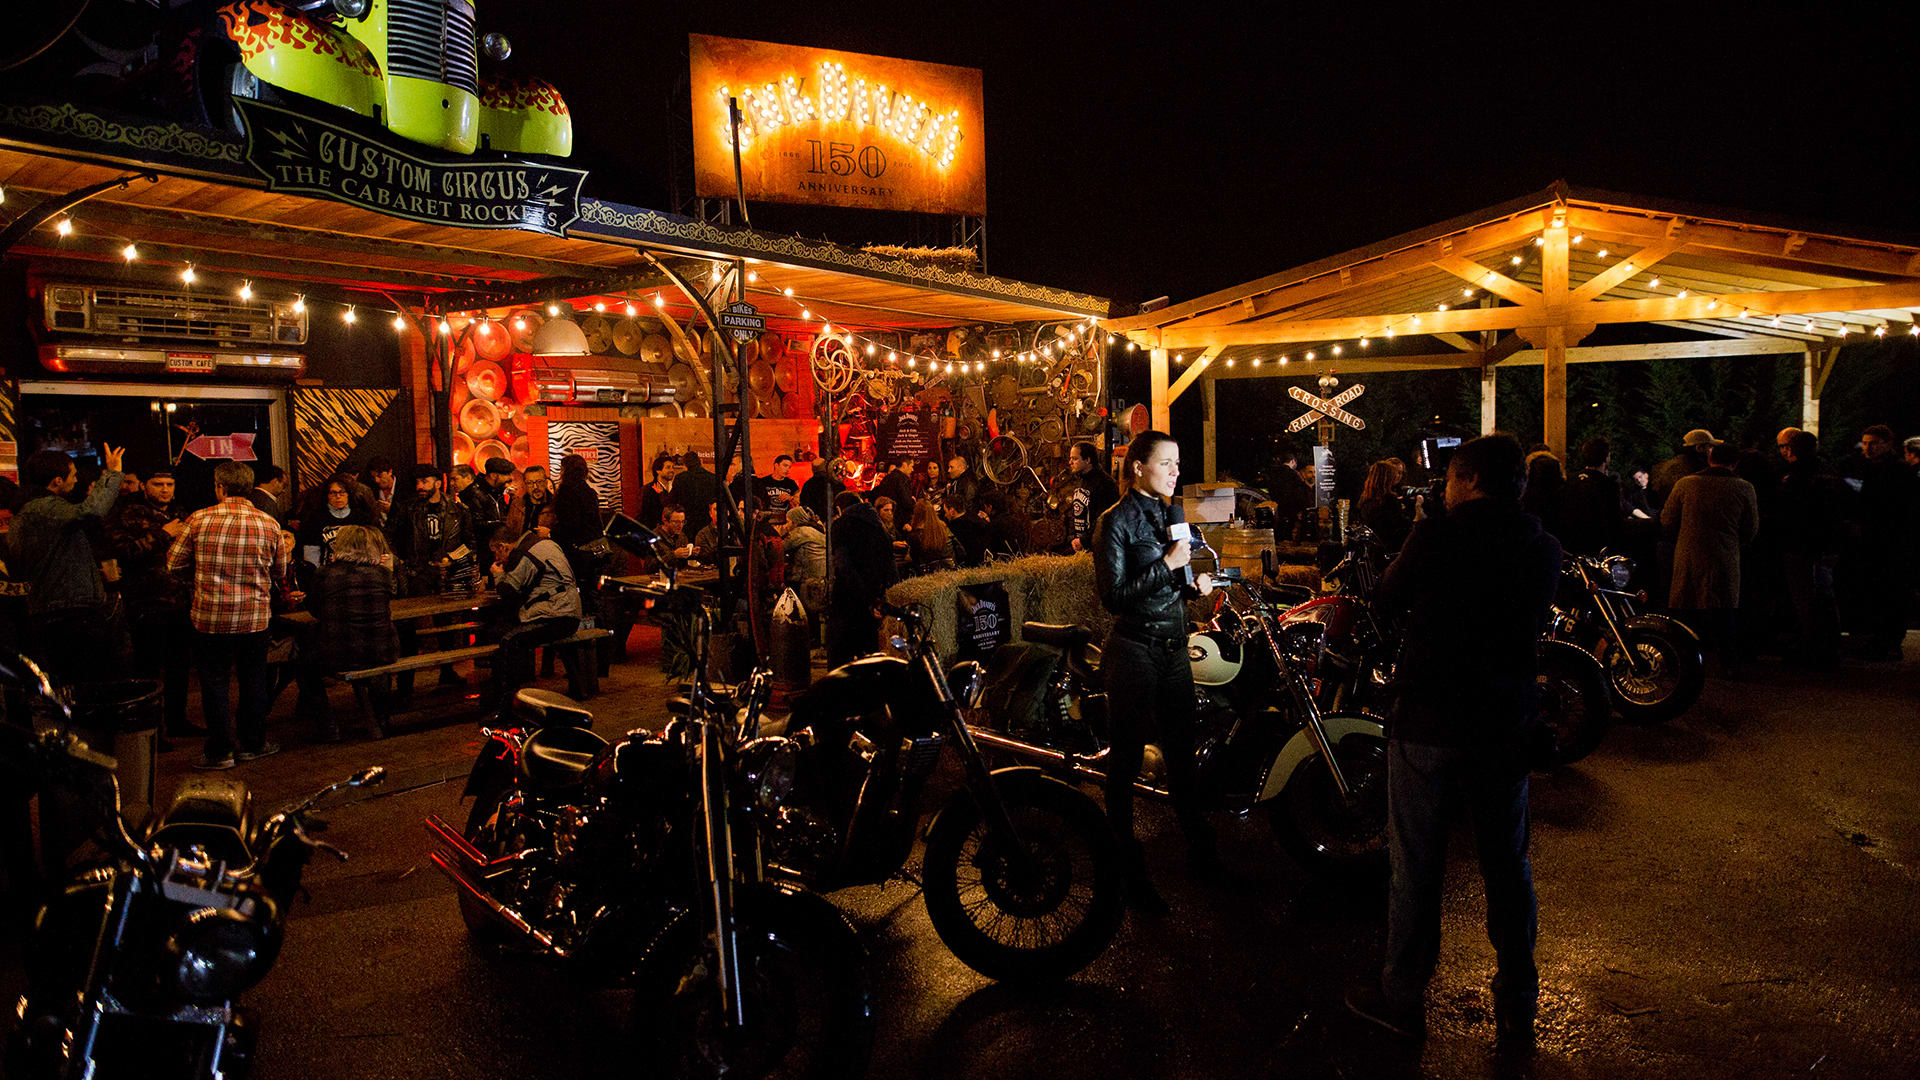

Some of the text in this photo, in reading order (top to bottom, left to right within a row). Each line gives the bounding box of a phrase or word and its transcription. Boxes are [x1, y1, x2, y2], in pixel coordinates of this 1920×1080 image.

[319, 131, 531, 201] CUSTOM CIRCUS
[806, 139, 887, 179] 150
[277, 165, 332, 187] THE
[341, 178, 452, 218] CABARET
[797, 181, 896, 198] ANNIVERSARY
[732, 303, 753, 315] BIKES
[724, 316, 762, 328] PARKING
[733, 329, 754, 341] ONLY
[169, 359, 194, 367] CUSTOM
[1292, 386, 1363, 432] RAIL ROAD
[1293, 389, 1361, 428] CROSSING
[210, 439, 234, 455] IN
